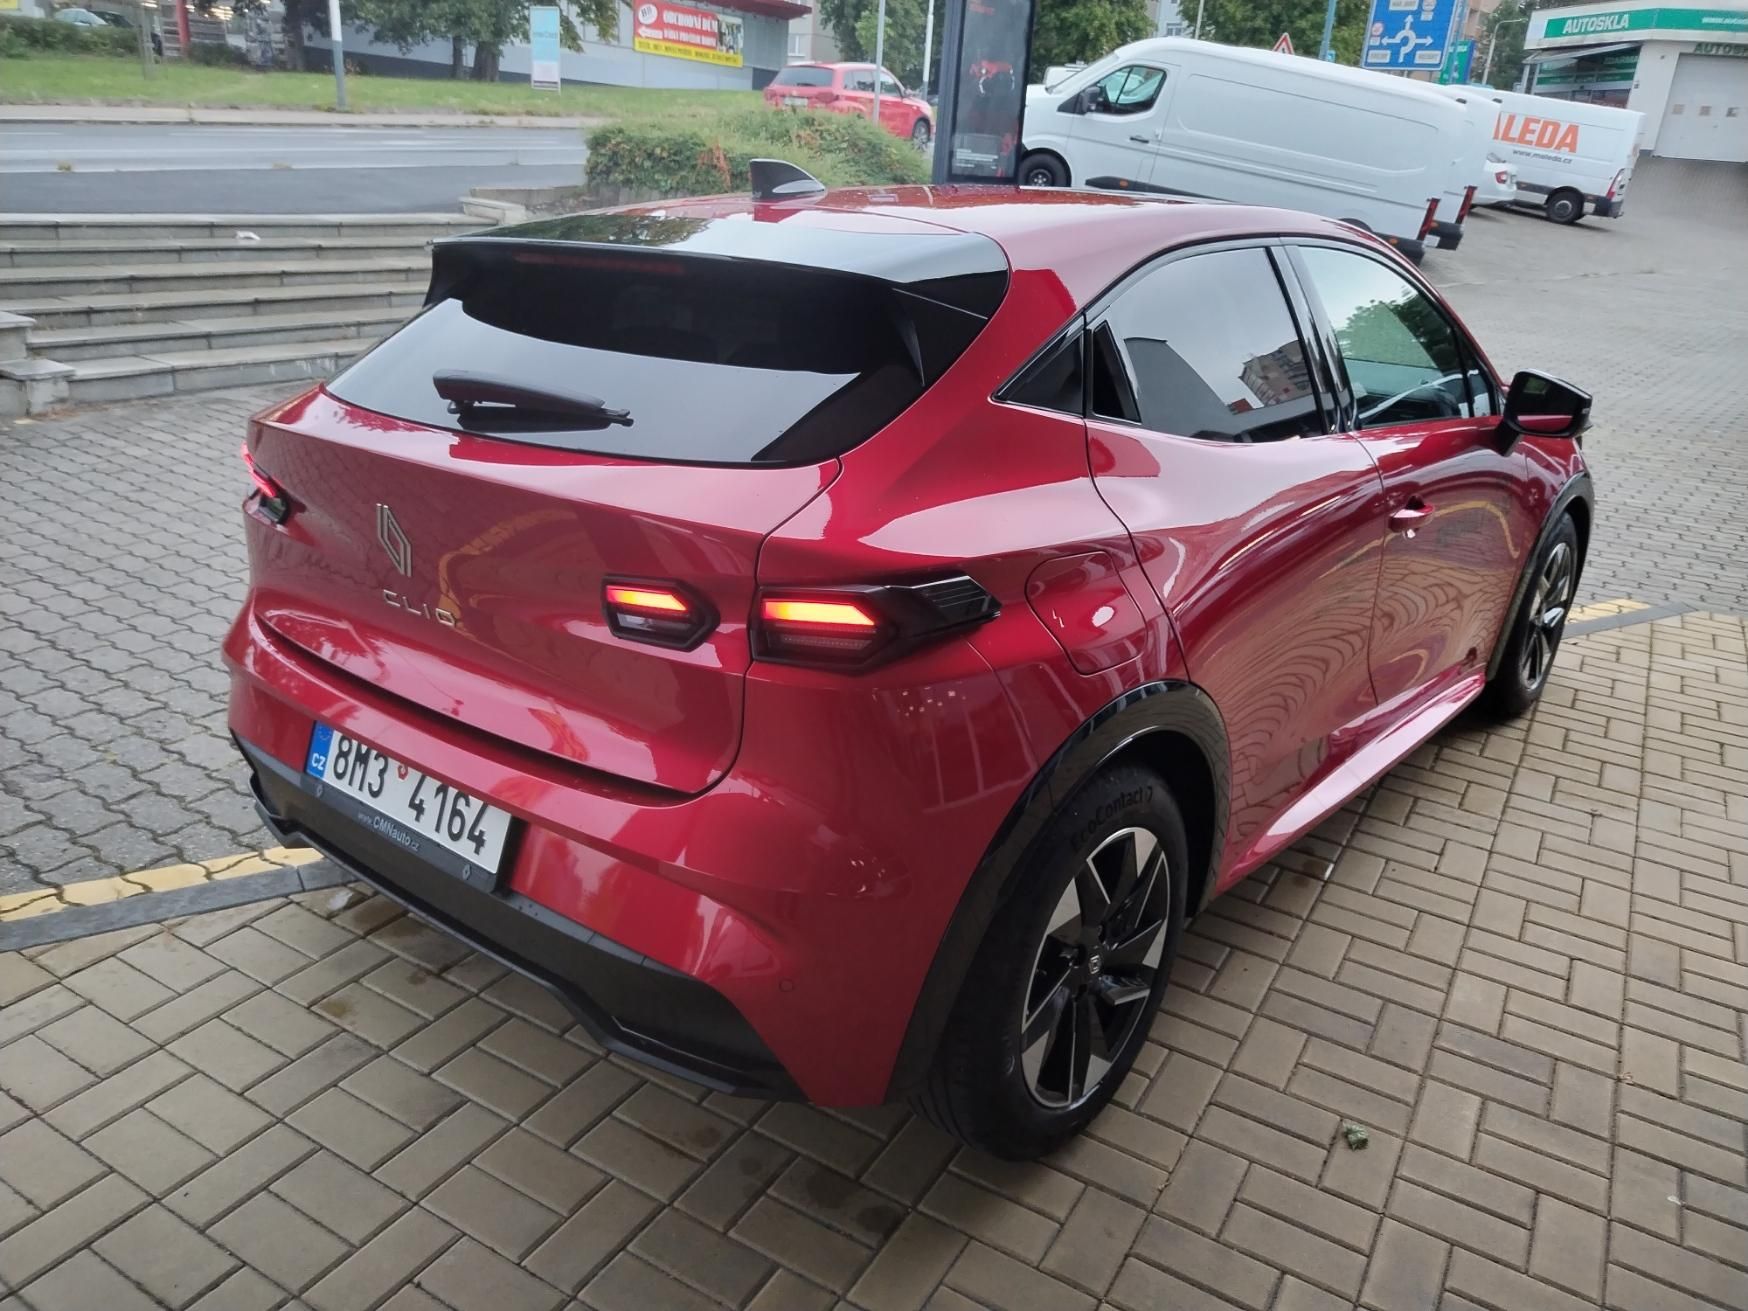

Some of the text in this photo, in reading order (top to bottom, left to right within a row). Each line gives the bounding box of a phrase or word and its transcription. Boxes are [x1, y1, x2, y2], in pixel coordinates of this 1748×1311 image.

[1562, 14, 1629, 35] AUTOSKLA
[383, 589, 456, 626] CLIO
[311, 753, 327, 771] CZ
[333, 734, 489, 856] 8M3 4164
